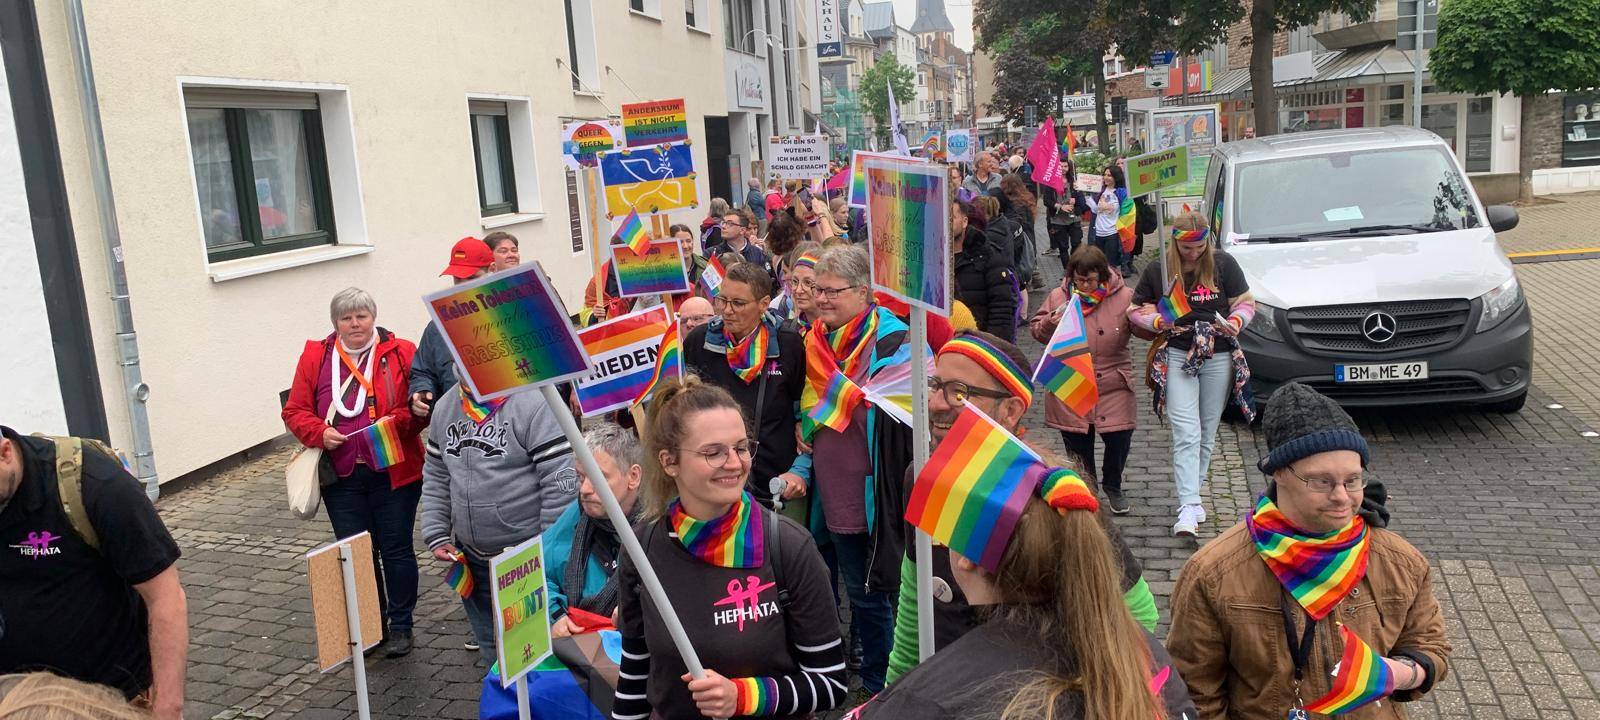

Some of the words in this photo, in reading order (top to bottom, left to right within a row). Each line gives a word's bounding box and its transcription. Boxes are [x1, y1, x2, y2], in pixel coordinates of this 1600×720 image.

[628, 103, 680, 115] ANDERSRUM
[650, 115, 676, 124] NICHT
[577, 130, 602, 138] QUEER
[634, 126, 678, 137] VERKEHRT
[579, 141, 604, 149] GEGEN
[1138, 152, 1176, 168] HEPHATA
[1139, 165, 1178, 185] BUNT
[439, 299, 480, 322] Keine
[459, 324, 566, 367] Rassismus
[578, 344, 661, 383] RIEDEN
[1349, 366, 1370, 380] BM
[1380, 365, 1400, 379] ME
[1403, 364, 1422, 378] 49
[20, 547, 61, 556] HEPHATA
[498, 556, 541, 592] HEPHATA
[503, 586, 544, 632] BUNT
[714, 601, 779, 626] HEPHATA
